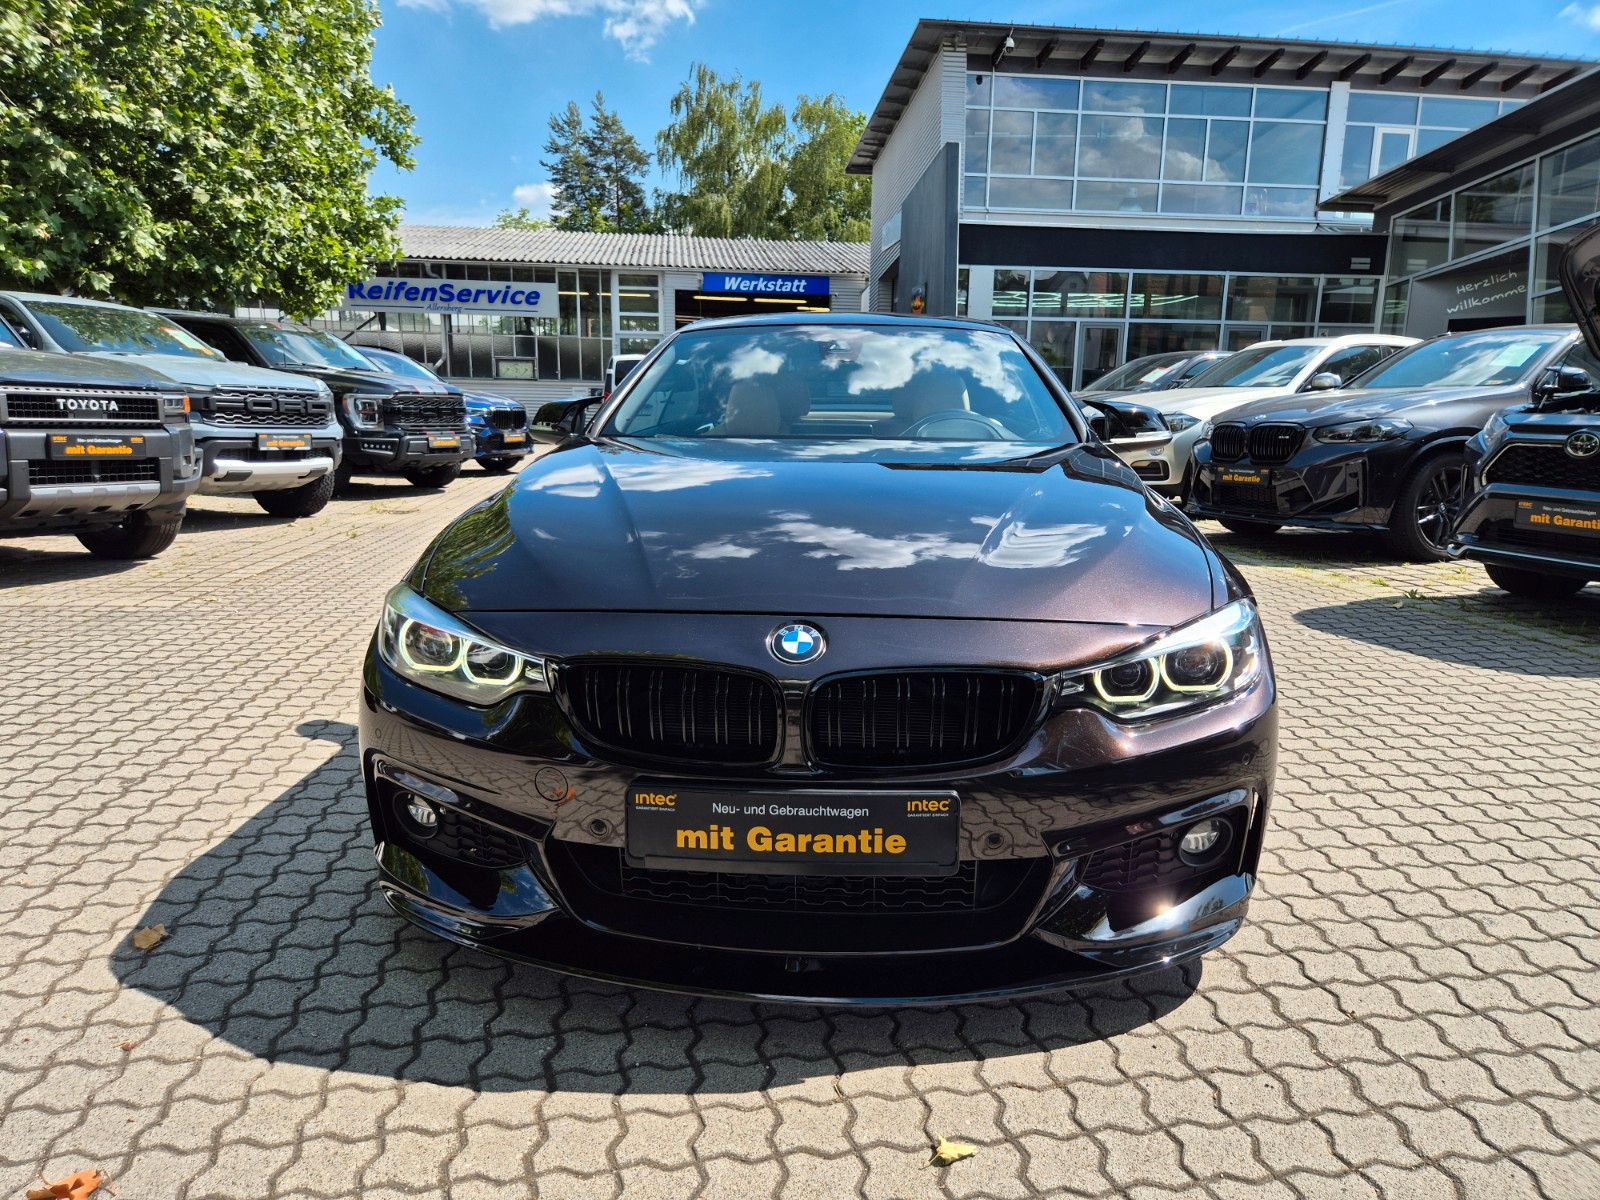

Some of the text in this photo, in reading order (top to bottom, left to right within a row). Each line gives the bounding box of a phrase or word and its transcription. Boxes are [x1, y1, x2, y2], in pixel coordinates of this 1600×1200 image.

[724, 276, 807, 293] Werkstatt
[1456, 267, 1518, 295] Herzlich
[349, 280, 541, 306] ReifenService
[1446, 284, 1527, 314] willkomme
[425, 303, 464, 315] Allersberg
[56, 398, 119, 411] TOYOTA
[207, 395, 330, 413] FORD
[1530, 513, 1600, 530] mit Garanti
[778, 625, 820, 638] BMW
[635, 793, 676, 807] intec
[907, 799, 950, 812] intec
[712, 802, 869, 819] Neu- und Gebrauchtwagen
[676, 824, 907, 854] mit Garantie
